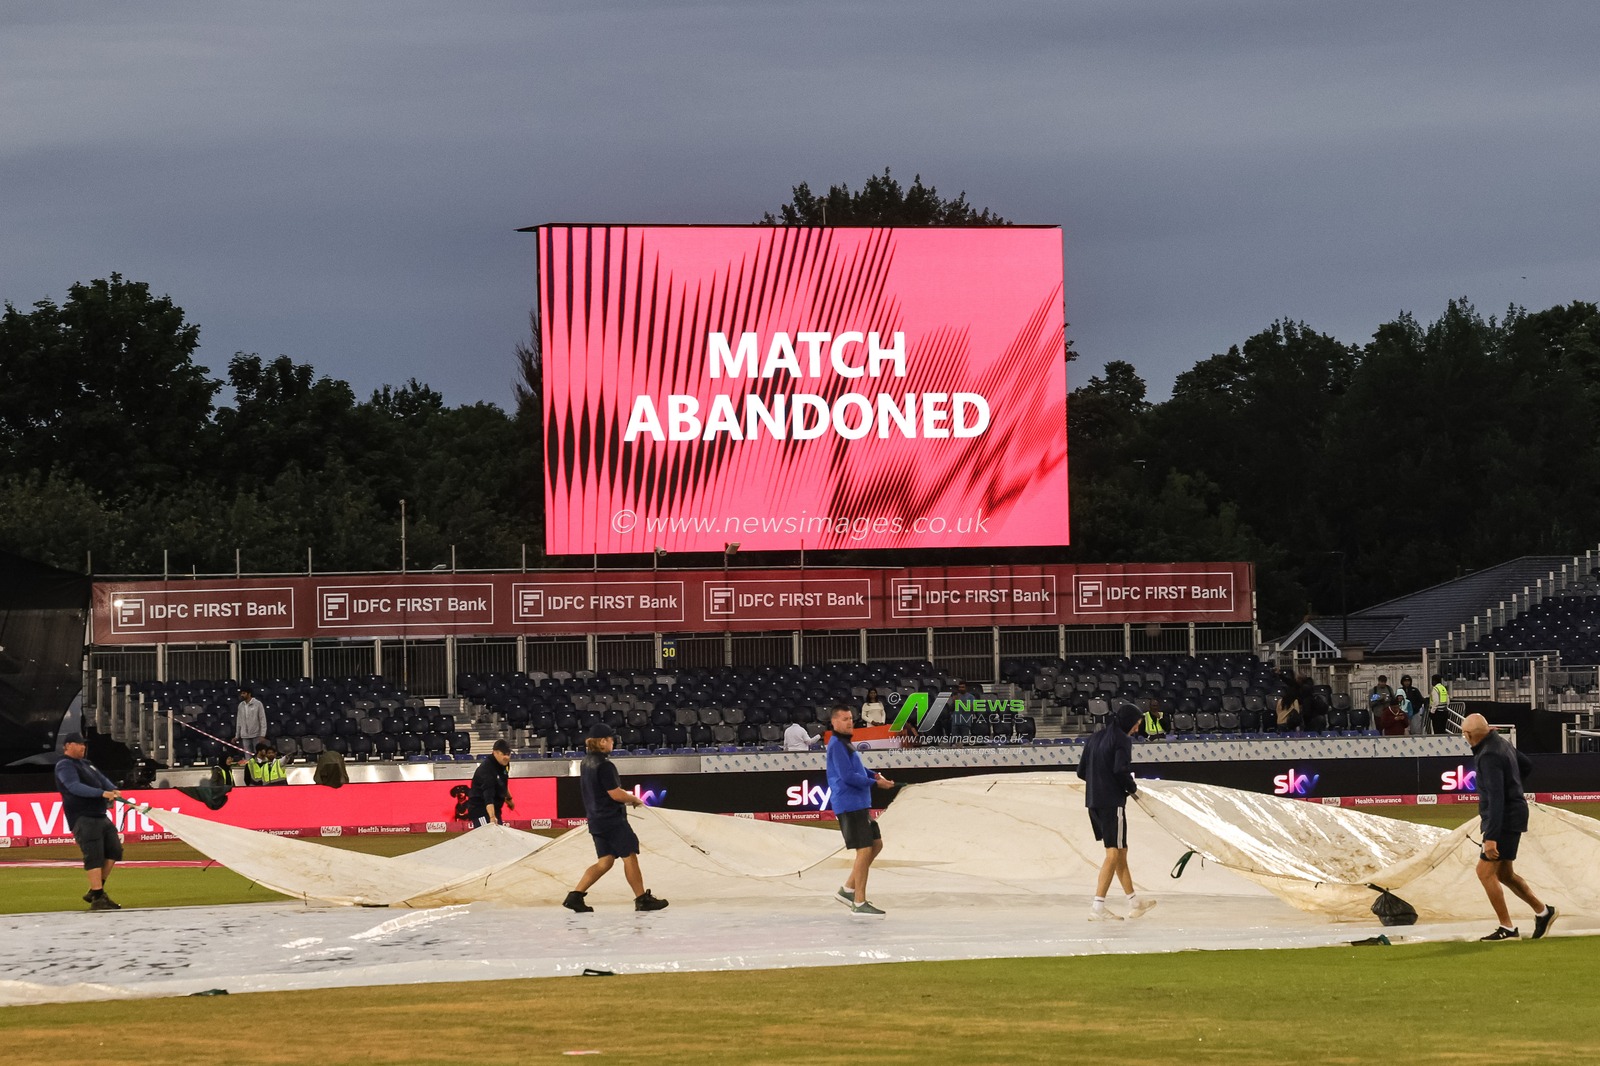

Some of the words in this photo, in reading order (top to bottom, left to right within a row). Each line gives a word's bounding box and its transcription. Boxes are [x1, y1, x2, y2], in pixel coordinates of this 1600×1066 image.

[708, 331, 907, 379] MATCH
[623, 392, 990, 442] ABANDONED
[739, 593, 774, 607] IDFC
[779, 593, 822, 607] FIRST
[827, 592, 864, 606] Bank
[926, 590, 961, 604] IDFC
[966, 589, 1008, 603] FIRST
[1013, 589, 1050, 602] Bank
[1107, 587, 1141, 600] IDFC
[1145, 586, 1187, 600] FIRST
[1191, 585, 1228, 599] Bank
[150, 604, 188, 619] IDFC
[194, 602, 242, 618] FIRST
[247, 601, 287, 616] Bank
[353, 598, 391, 613] IDFC
[397, 597, 443, 612] FIRST
[448, 597, 487, 611] Bank
[548, 596, 585, 610] IDFC
[590, 595, 634, 609] FIRST
[640, 595, 677, 609] Bank
[663, 648, 675, 657] 30
[1274, 769, 1319, 794] sky
[787, 780, 832, 811] sky
